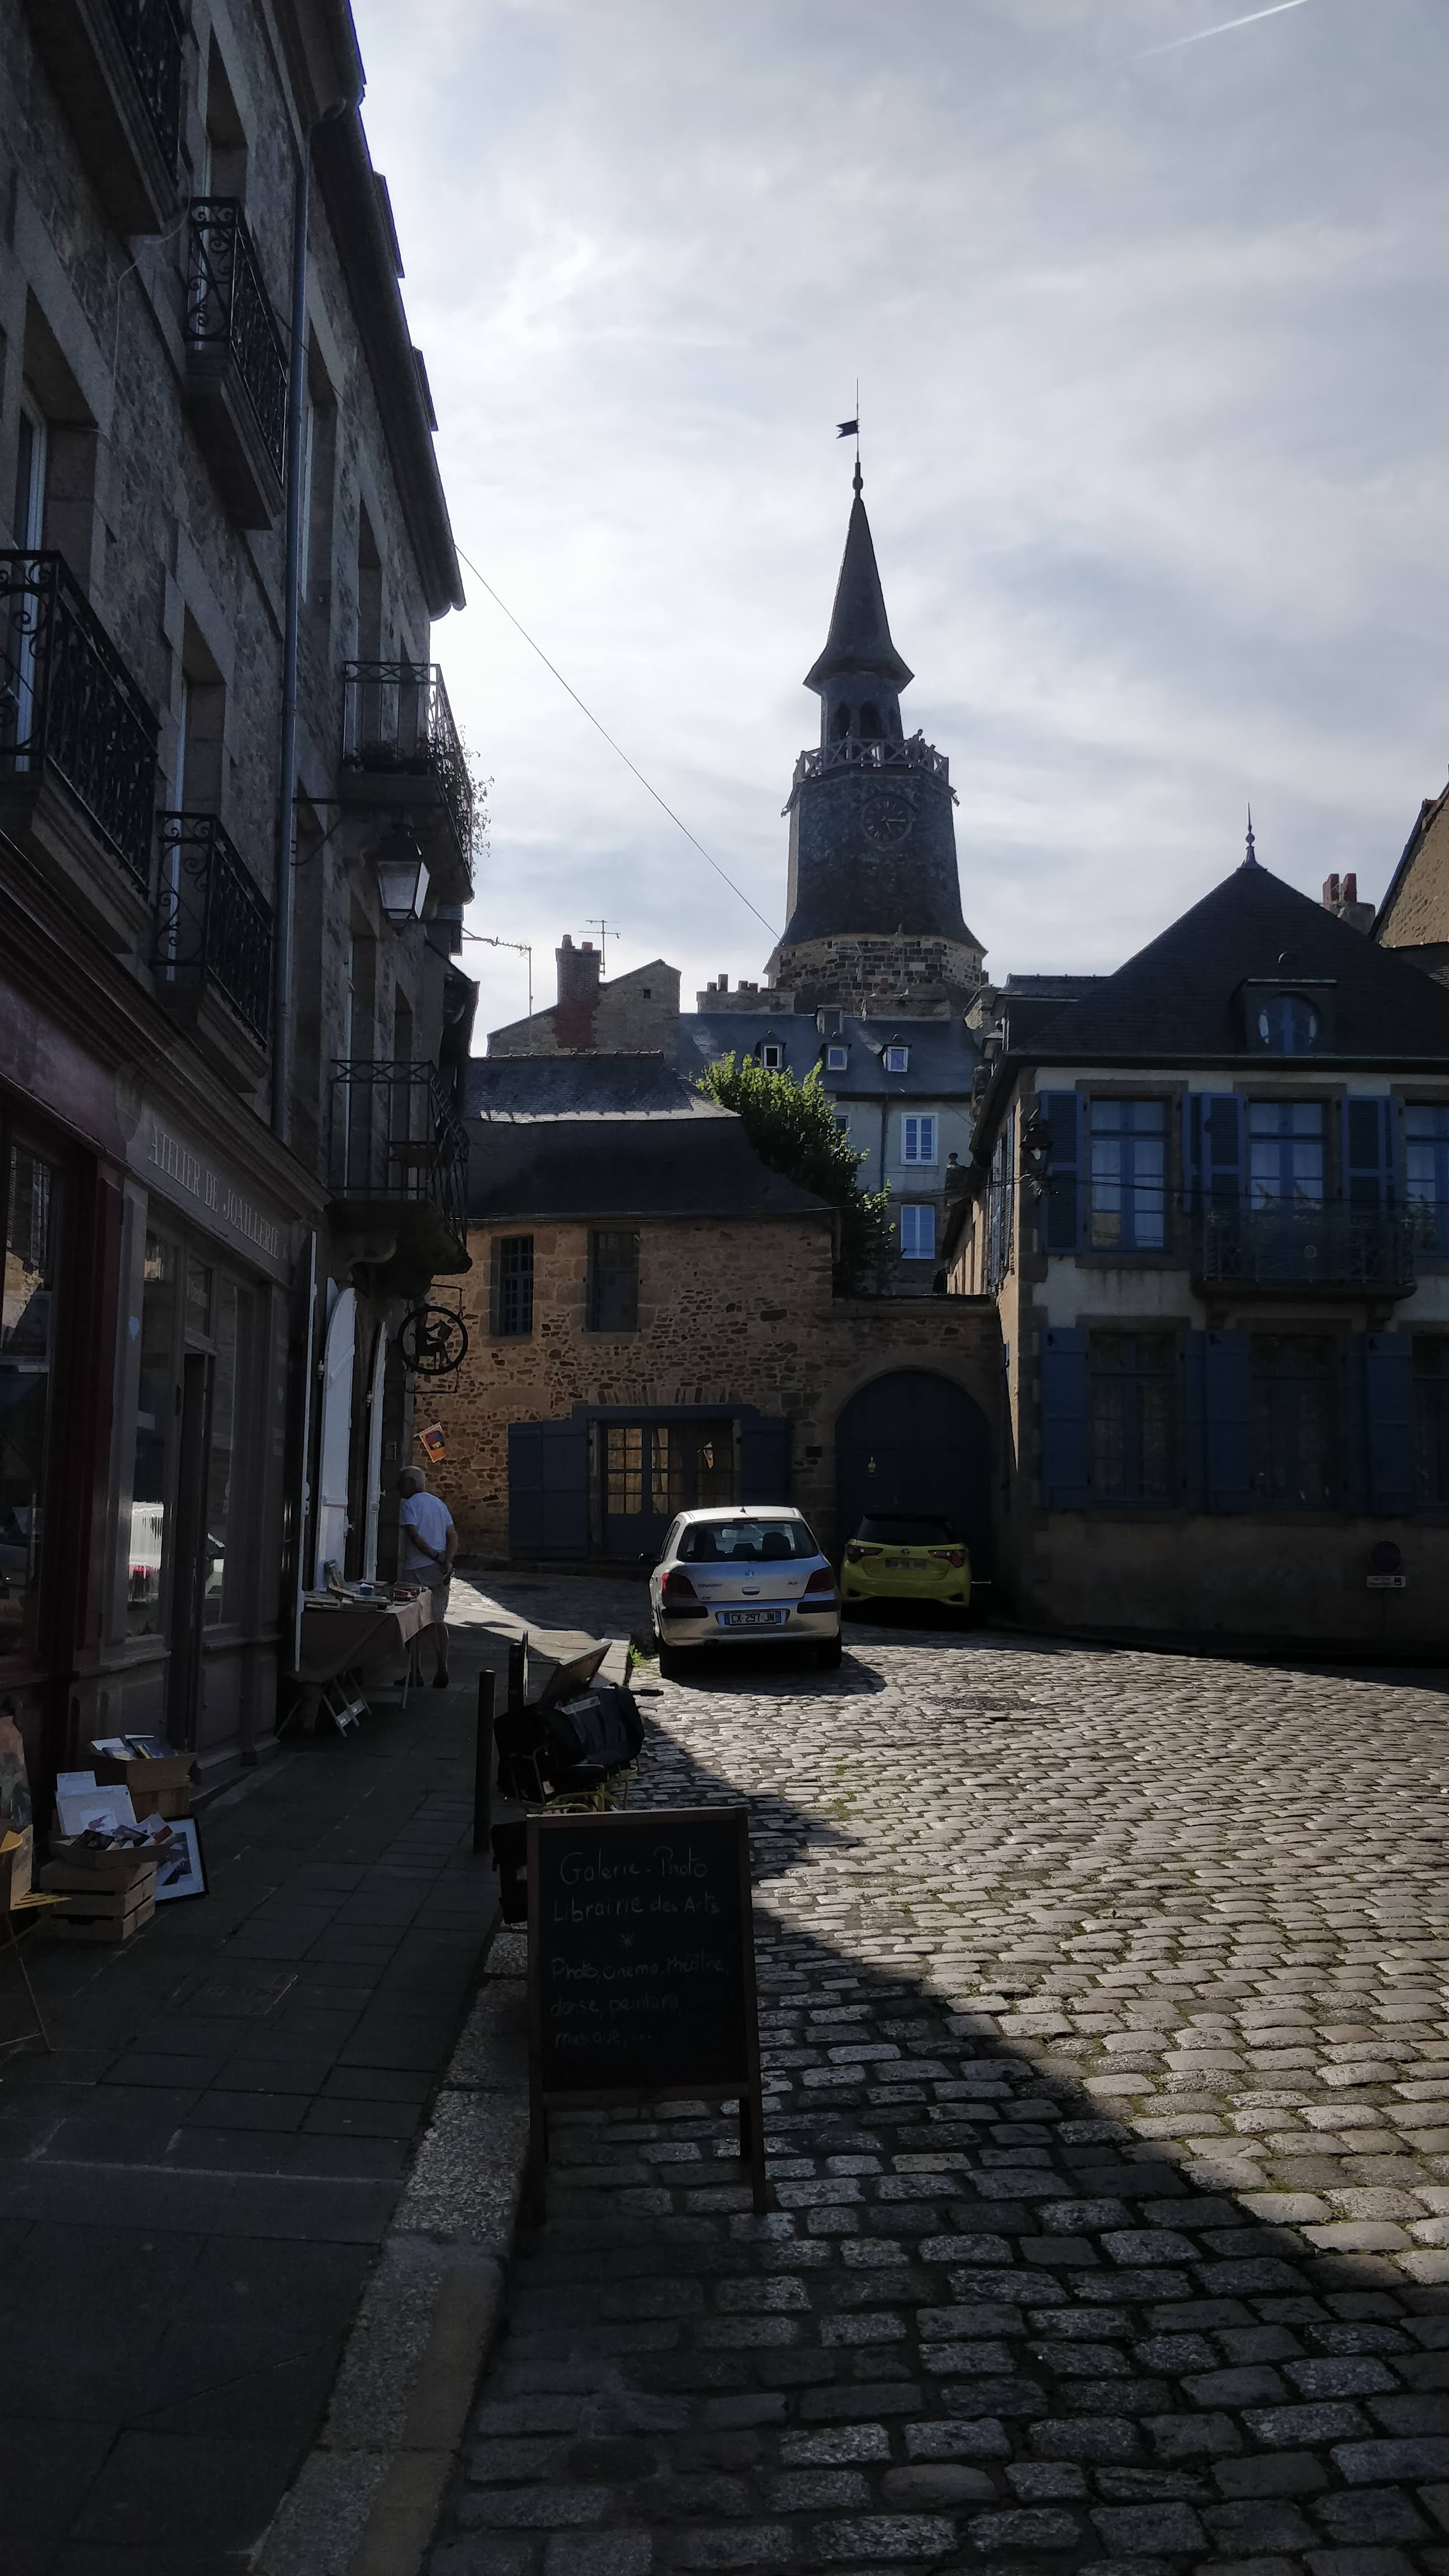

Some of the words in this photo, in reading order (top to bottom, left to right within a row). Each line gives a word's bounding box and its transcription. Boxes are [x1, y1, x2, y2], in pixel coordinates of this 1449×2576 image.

[148, 1124, 201, 1199] ATELIER
[203, 1169, 219, 1213] DE
[223, 1188, 279, 1260] JOAILLERIE
[560, 1846, 640, 1885] Galerie
[653, 1845, 708, 1879] Photo
[554, 1895, 643, 1923] Librairie
[650, 1893, 679, 1914] des
[684, 1889, 721, 1915] Arts
